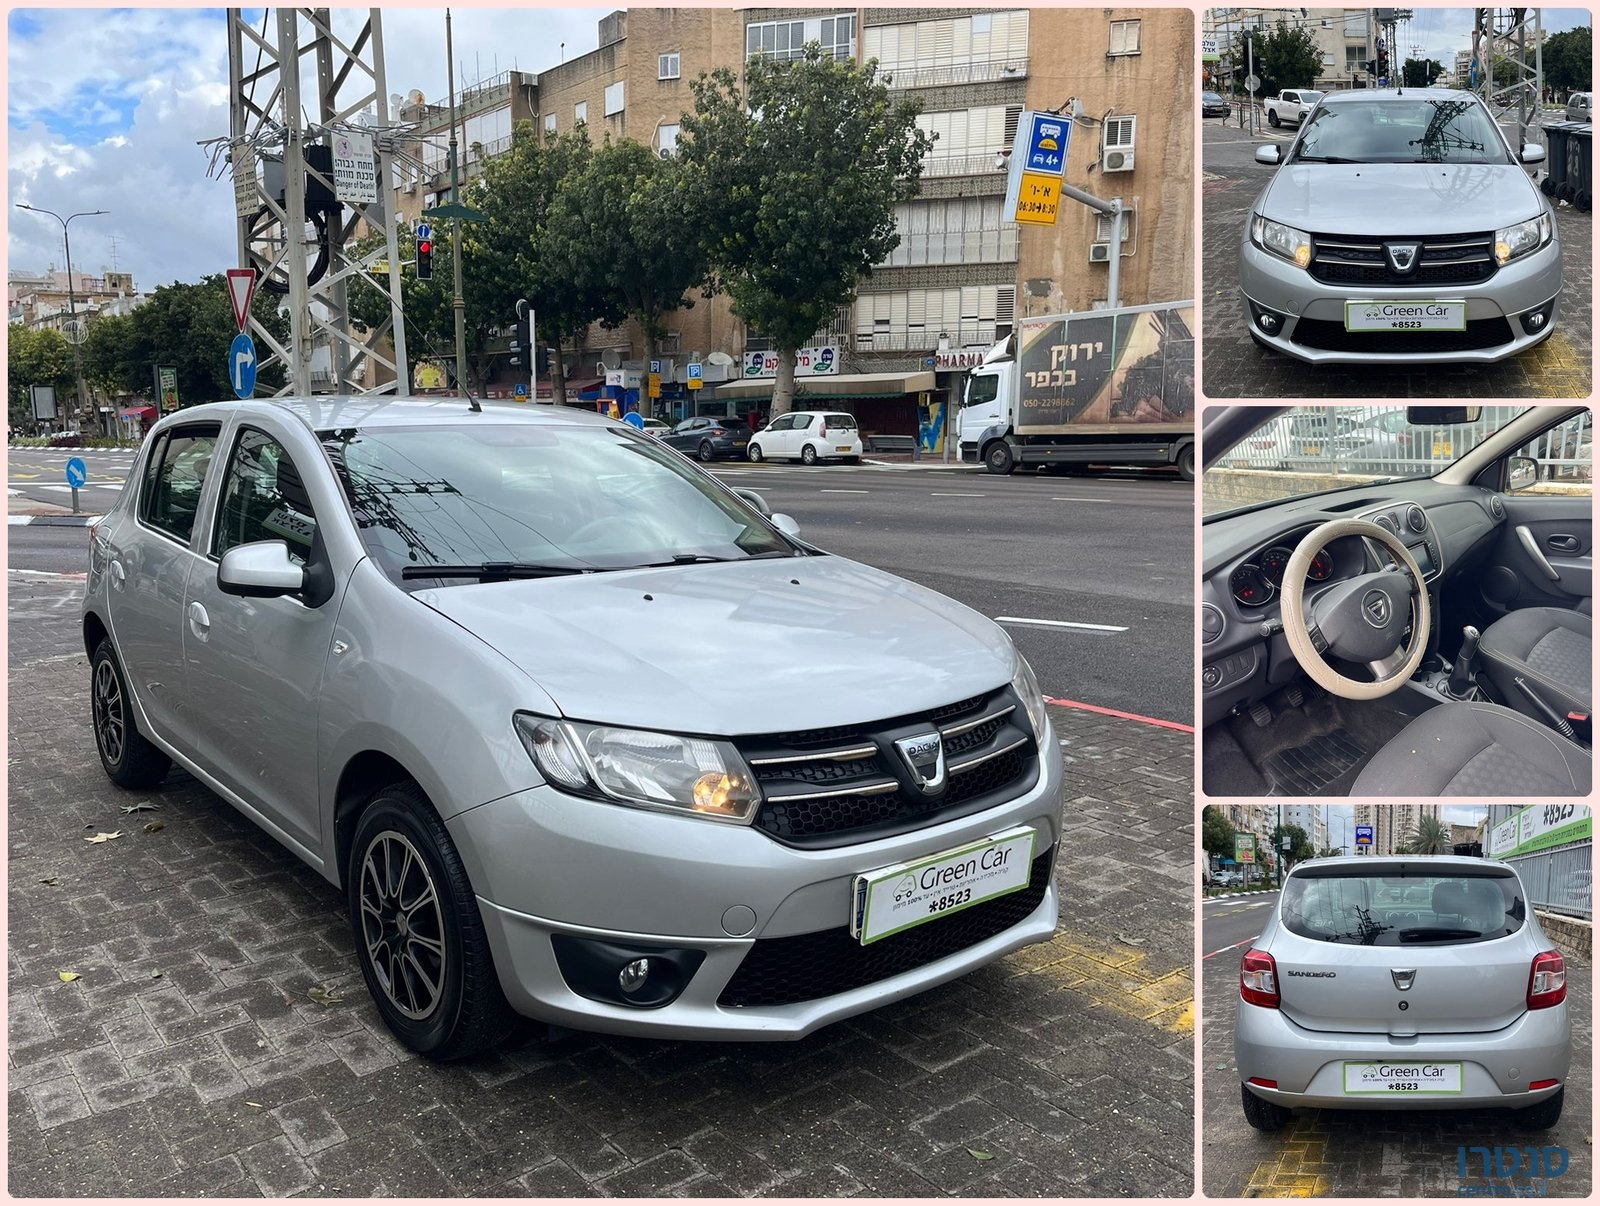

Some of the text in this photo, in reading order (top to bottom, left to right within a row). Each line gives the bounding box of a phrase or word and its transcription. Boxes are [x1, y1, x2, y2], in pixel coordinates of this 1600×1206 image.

[335, 158, 373, 170] מתח גבוה!
[1045, 154, 1058, 165] 4+
[335, 169, 374, 180] סכנת מוות!
[1382, 304, 1449, 316] Green Car
[936, 353, 983, 367] PHARMA
[1050, 342, 1103, 370] ירוק
[1024, 370, 1077, 388] בכפר
[909, 741, 937, 755] DACIA
[920, 848, 1012, 890] Green Car
[1287, 970, 1337, 978] SANDERO
[1380, 1064, 1446, 1077] Green Car
